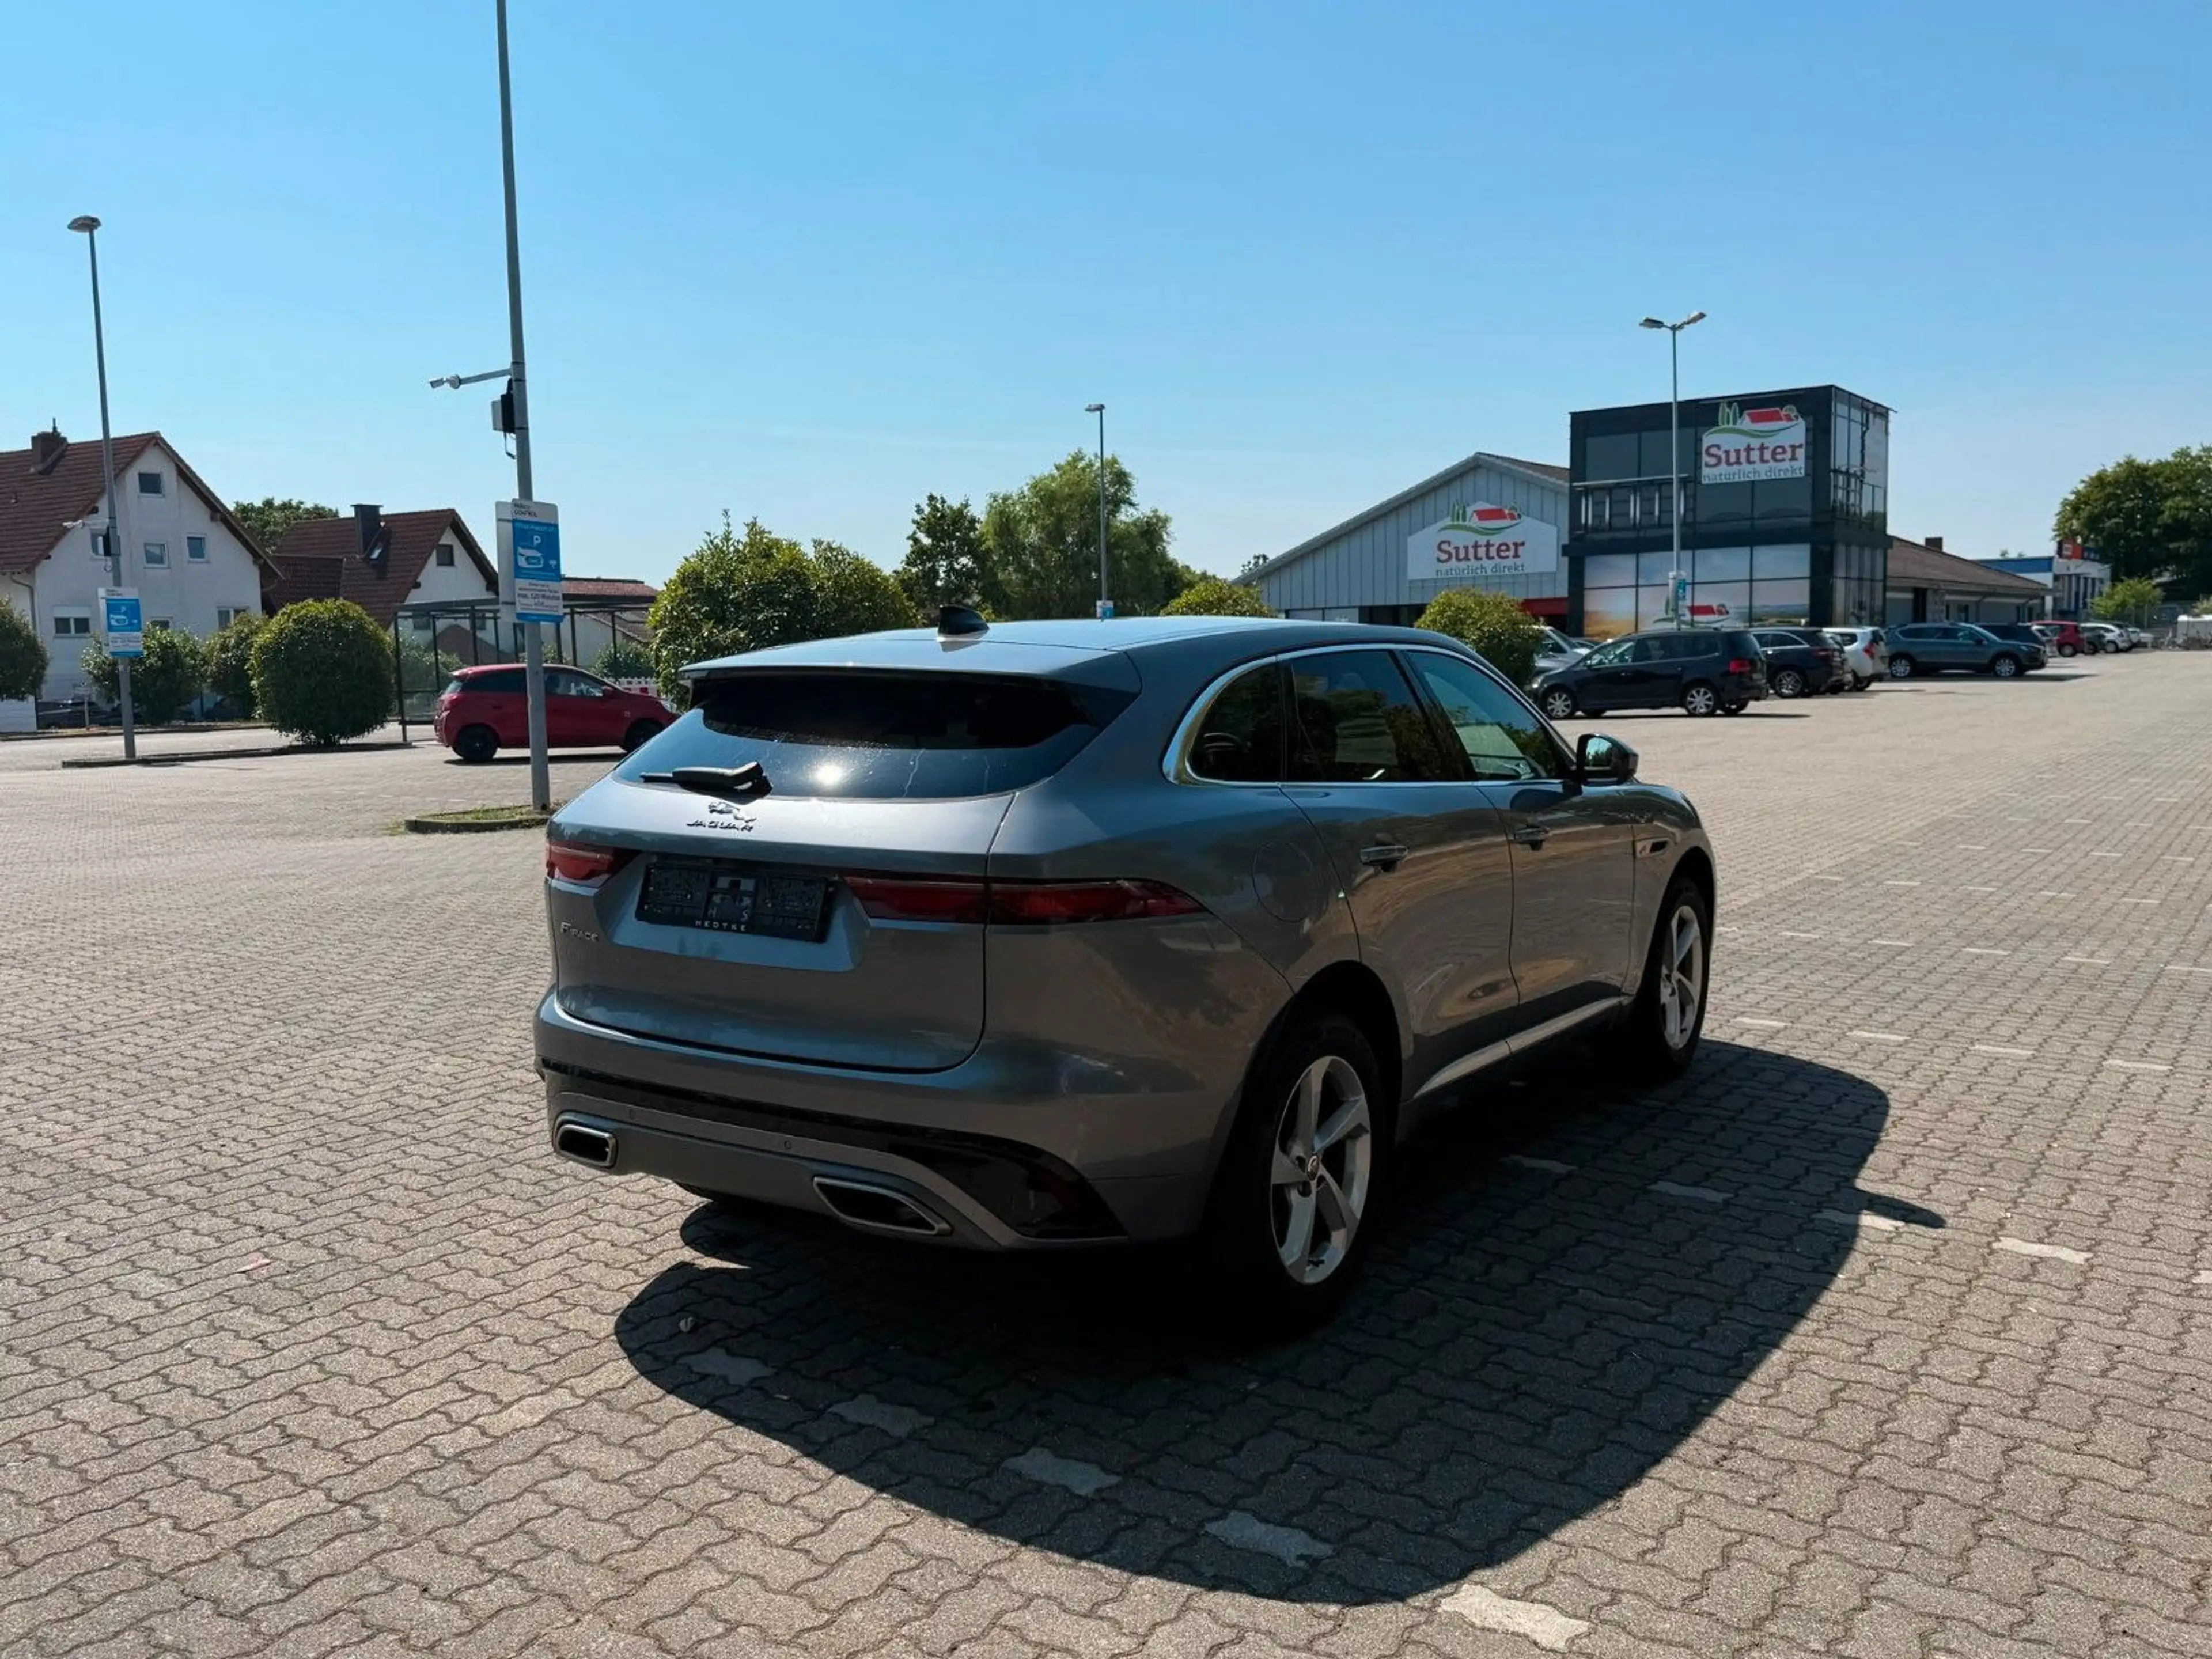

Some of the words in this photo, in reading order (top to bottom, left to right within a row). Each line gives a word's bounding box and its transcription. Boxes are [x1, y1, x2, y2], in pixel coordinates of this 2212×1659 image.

[1705, 442, 1804, 468] Sutter
[1703, 468, 1760, 483] natürlich
[1765, 466, 1803, 479] direkt
[533, 535, 541, 546] P
[1436, 540, 1525, 563] Sutter
[1436, 564, 1487, 576] natürlich
[1491, 563, 1525, 574] direkt
